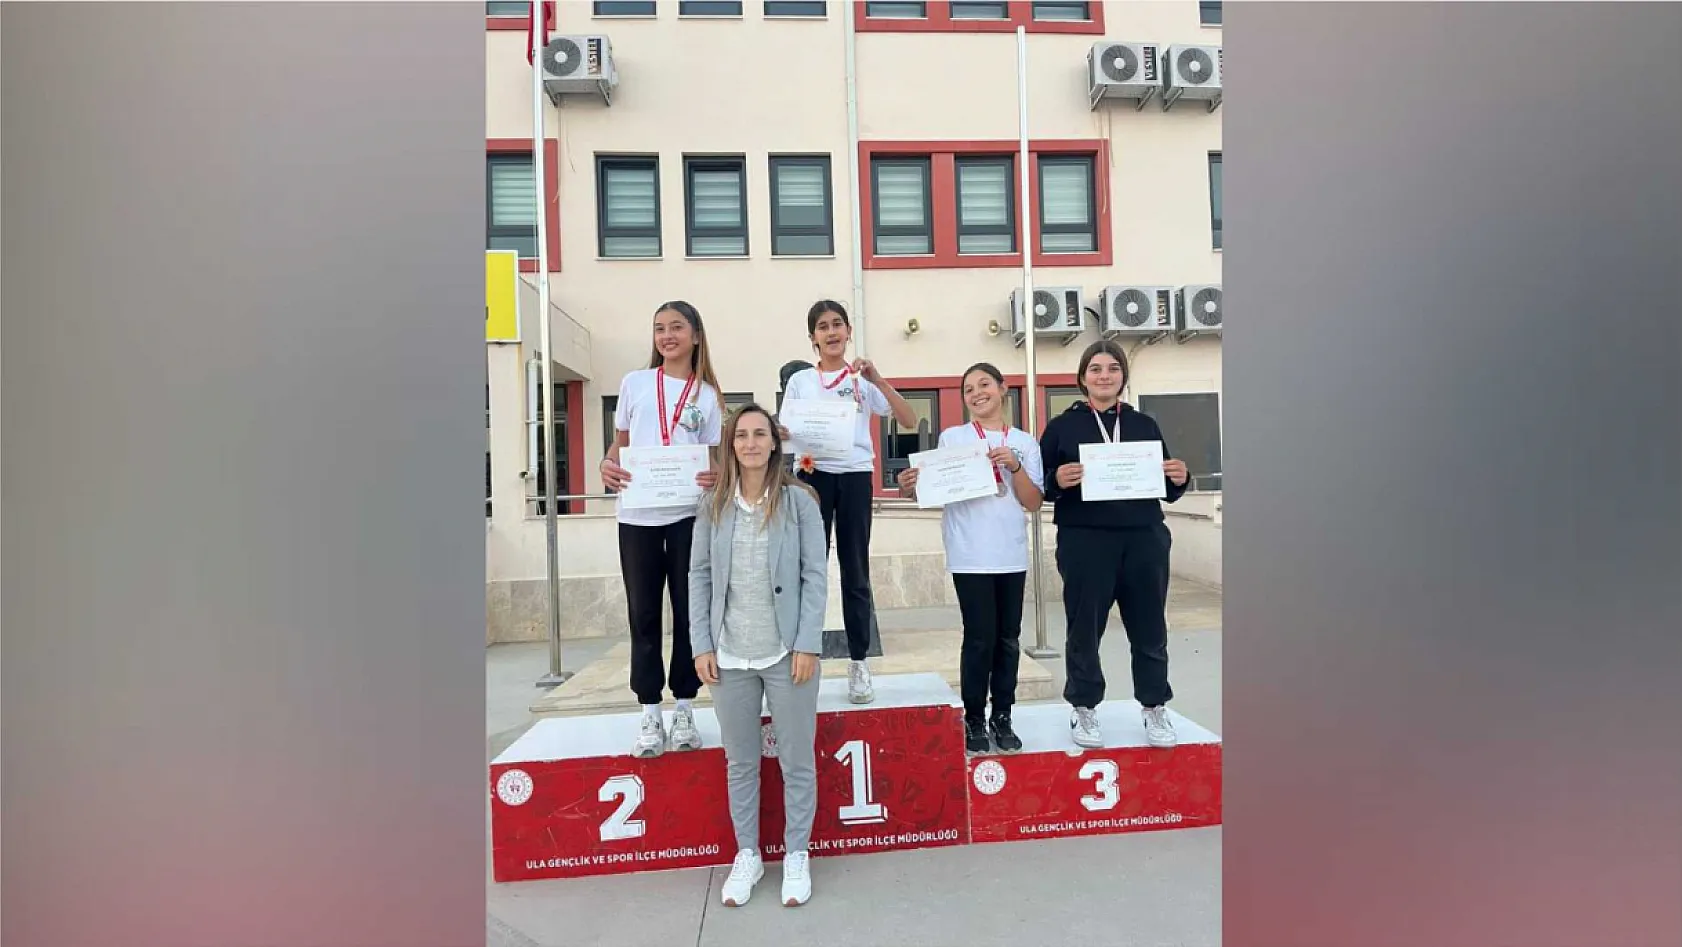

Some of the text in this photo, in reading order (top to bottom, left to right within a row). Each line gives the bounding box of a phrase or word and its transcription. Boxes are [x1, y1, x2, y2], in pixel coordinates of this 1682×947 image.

[834, 740, 888, 824] 1
[1078, 759, 1121, 811] 3
[598, 774, 646, 841] 2
[1020, 825, 1037, 834] ULA
[1038, 820, 1075, 834] GENÇLİK
[1076, 820, 1087, 830] VE
[1088, 819, 1111, 829] SPOR
[1111, 816, 1129, 829] İLÇE
[525, 844, 720, 869] ULA GENÇLİK VE SPOR İLÇE MÜDÜRLÜĞÜ
[765, 830, 958, 854] ULA ÇLİK VE SPOR İLÇE MÜDÜRLÜĞÜ
